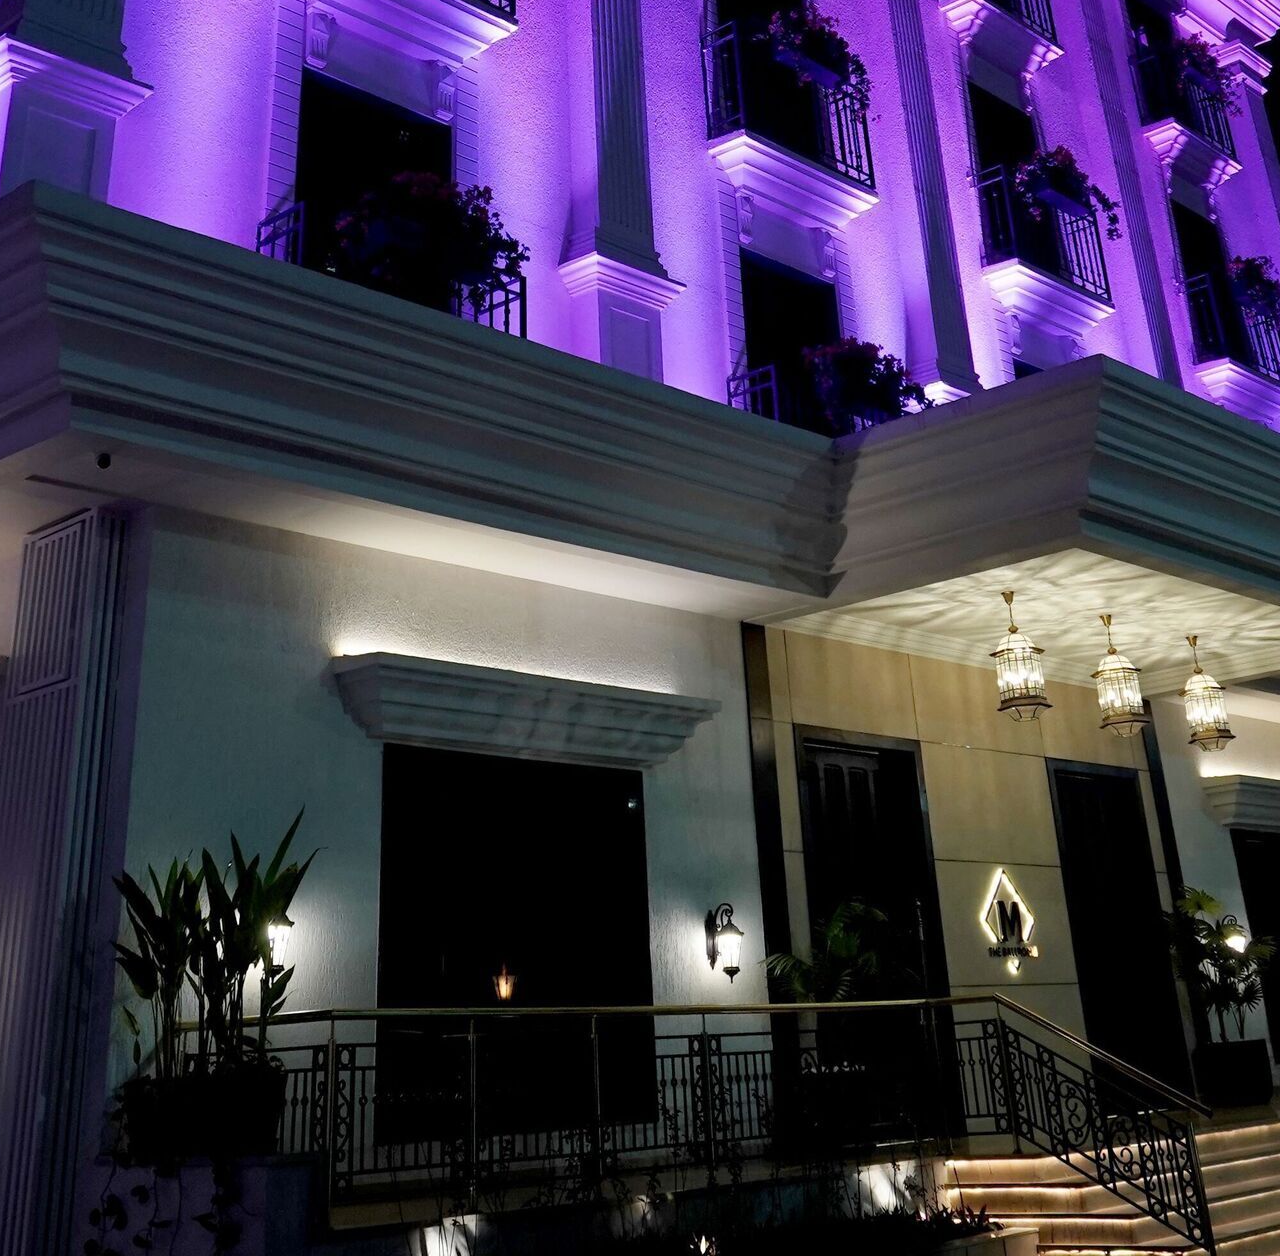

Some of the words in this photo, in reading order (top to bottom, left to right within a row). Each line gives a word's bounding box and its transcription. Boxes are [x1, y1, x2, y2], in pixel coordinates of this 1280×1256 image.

[995, 900, 1024, 942] M
[988, 946, 1002, 957] THE
[1002, 946, 1037, 958] BALLRO
